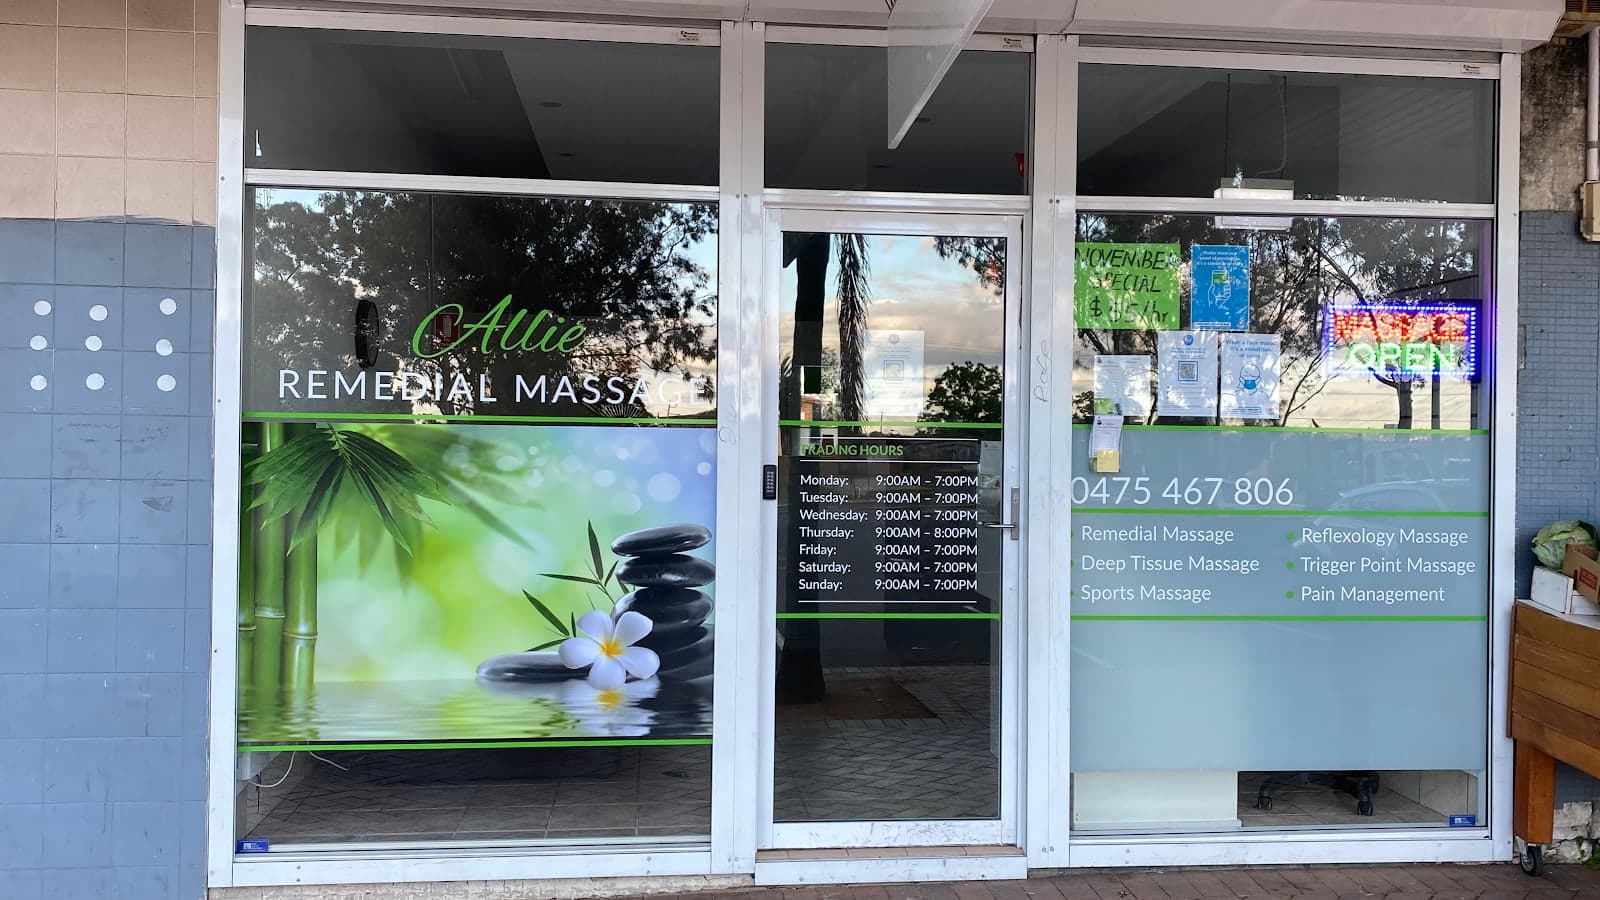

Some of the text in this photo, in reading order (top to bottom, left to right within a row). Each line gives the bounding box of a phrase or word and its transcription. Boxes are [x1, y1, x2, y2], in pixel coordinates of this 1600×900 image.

[1090, 272, 1161, 293] SPECIAL
[412, 294, 587, 359] Allie
[1334, 311, 1470, 341] MASSAGE
[1346, 342, 1456, 371] OPEN
[279, 369, 708, 406] REMEDIAL MASSAGE
[800, 444, 904, 456] TRADING HOURS
[801, 475, 848, 487] Monday:
[876, 475, 920, 485] 9:00AM
[935, 476, 979, 486] 7:00PM
[800, 492, 848, 504] Tuesday:
[876, 493, 920, 503] 9:00AM
[935, 493, 979, 503] 7:00PM
[1070, 477, 1293, 505] 0475 467 806
[800, 509, 867, 522] Wednesday:
[876, 510, 920, 520] 9:00AM
[935, 510, 979, 521] 7:00PM
[799, 527, 853, 539] Thursday:
[876, 527, 920, 537] 9:00AM
[935, 528, 978, 538] 8:00PM
[1082, 526, 1233, 544] Remedial Massage
[1303, 528, 1468, 546] Reflexology Massage
[800, 544, 836, 557] Friday:
[875, 545, 919, 555] 9:00AM
[934, 545, 978, 555] 7:00PM
[799, 561, 850, 574] Saturday:
[875, 562, 919, 572] 9:00AM
[934, 562, 978, 572] 7:00PM
[1082, 555, 1259, 574] Deep Tissue Massage
[1300, 557, 1475, 575] Trigger Point Massage
[799, 579, 842, 591] Sunday:
[875, 579, 919, 589] 9:00AM
[934, 580, 978, 590] 7:00PM
[1082, 585, 1211, 603] Sports Massage
[1302, 586, 1445, 604] Pain Management
